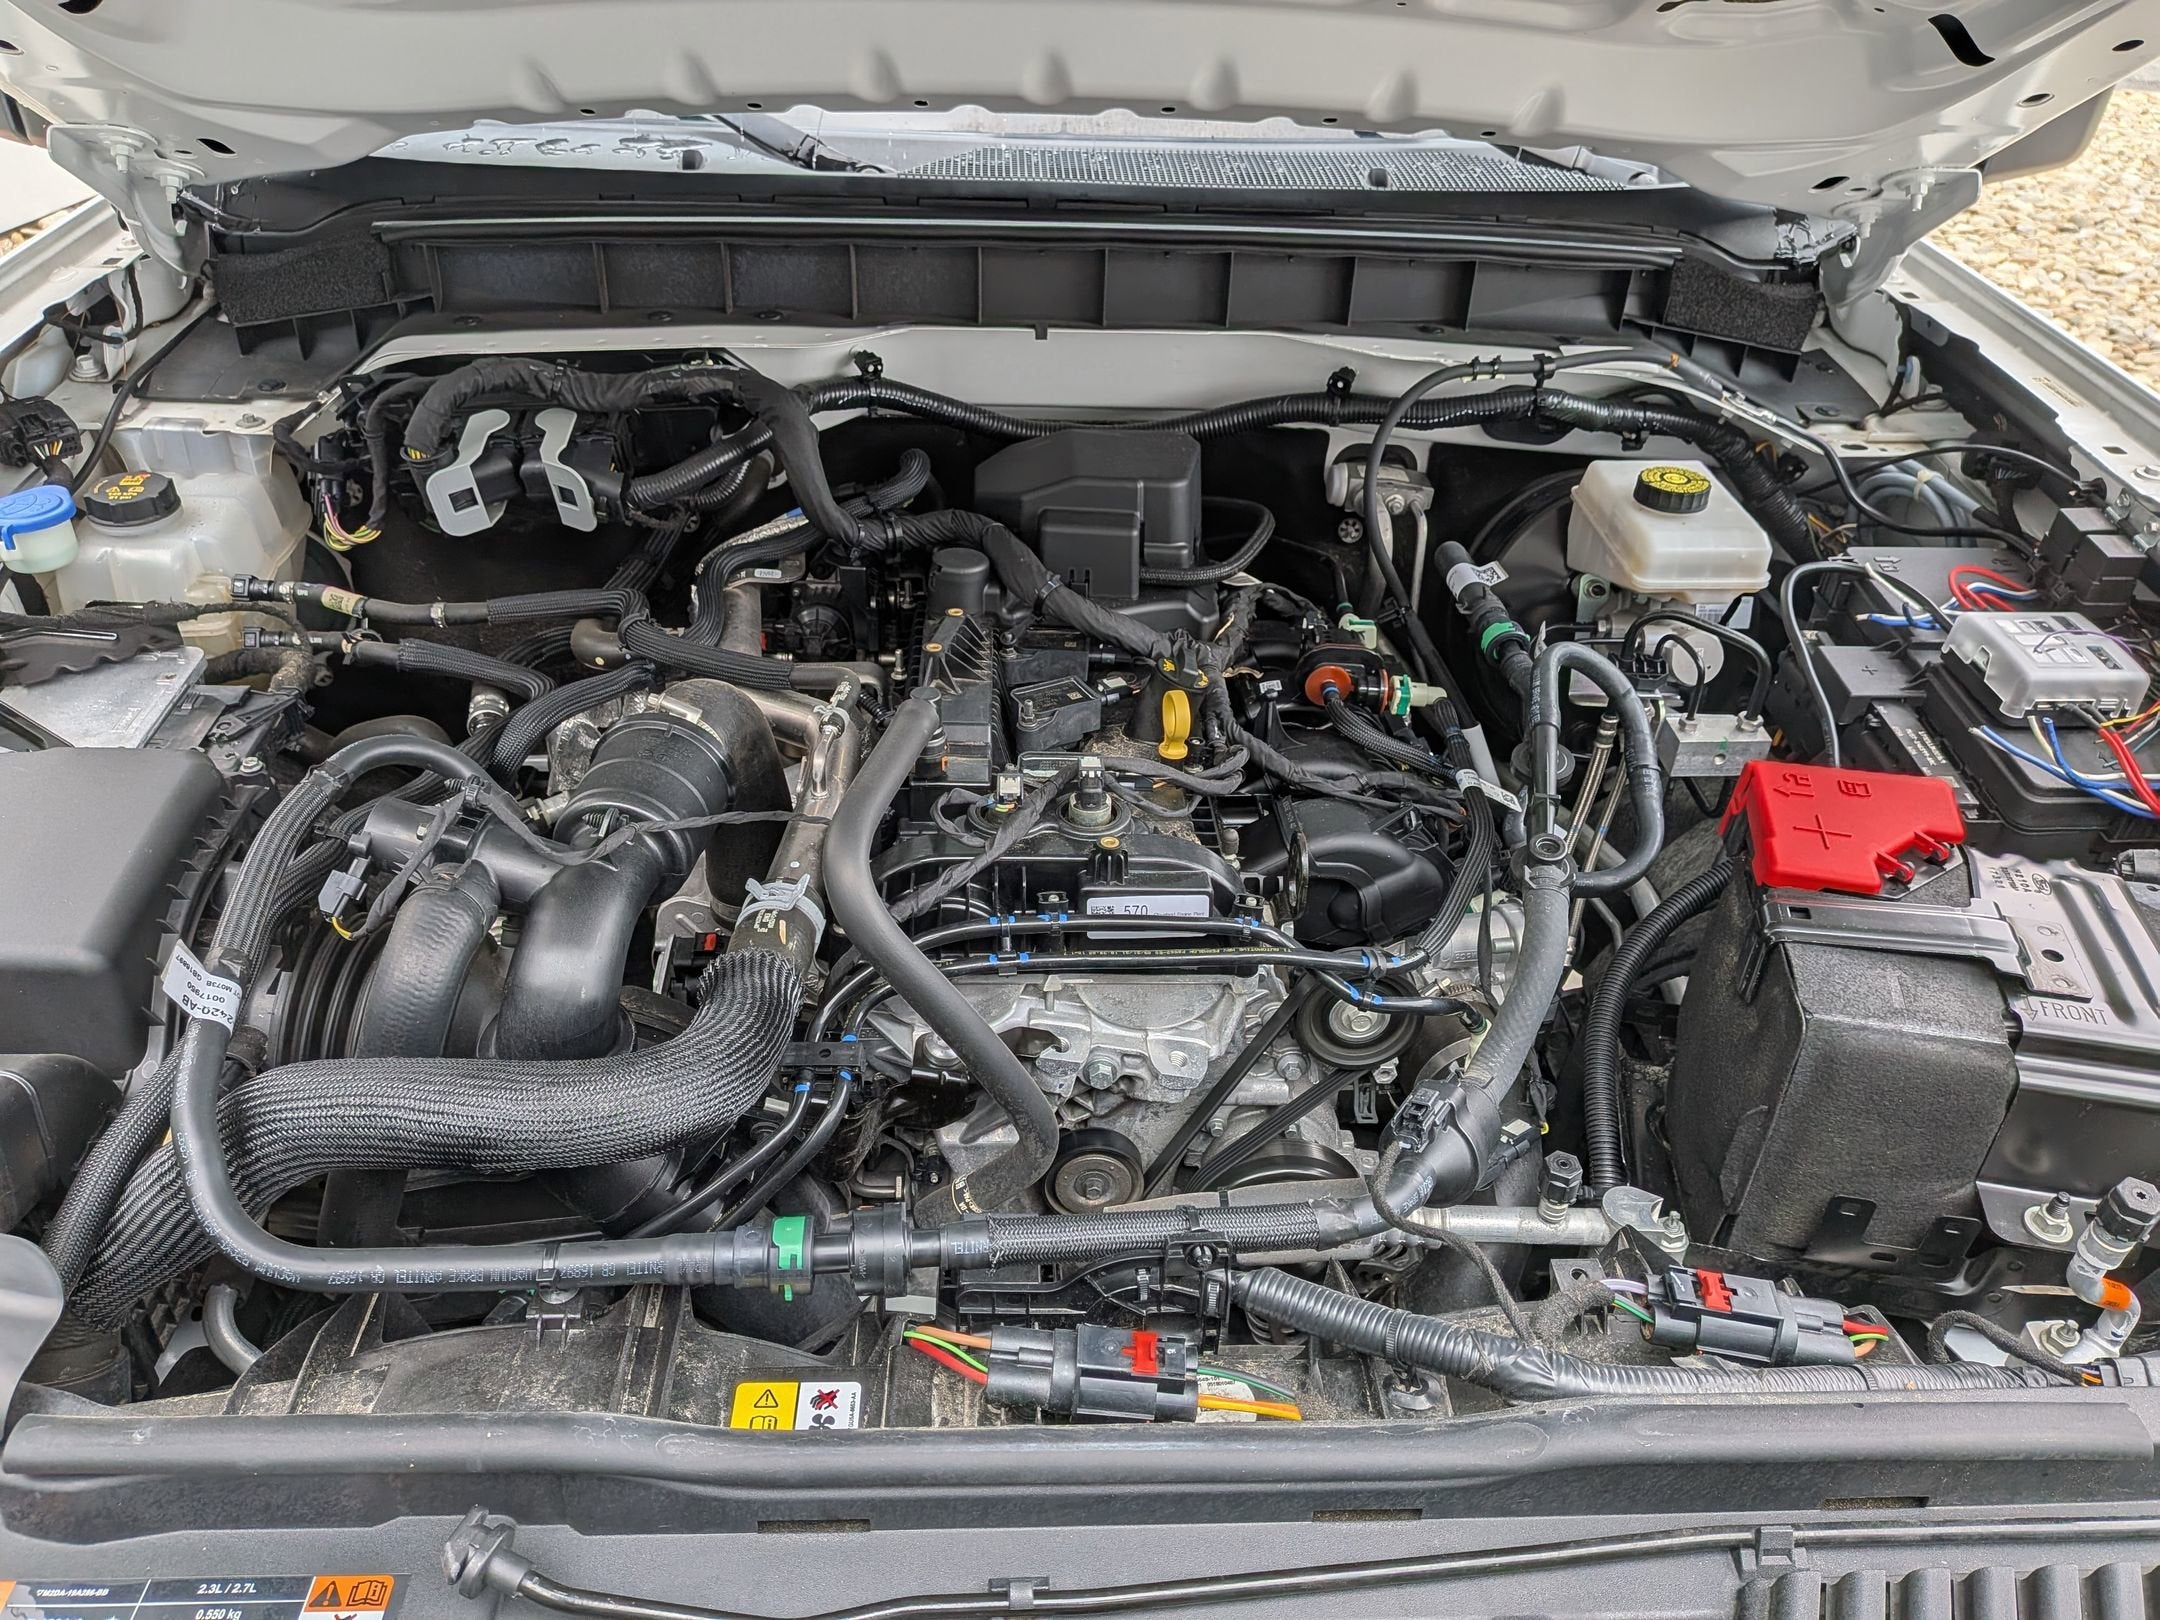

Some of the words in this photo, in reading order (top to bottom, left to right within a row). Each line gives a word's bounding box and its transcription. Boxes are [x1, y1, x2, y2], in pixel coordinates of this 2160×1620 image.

[2040, 1001, 2109, 1025] FRONT
[197, 1583, 223, 1594] 2.3L
[231, 1582, 257, 1593] 2.7L
[194, 1608, 227, 1620] 0.550
[228, 1608, 242, 1620] kg
